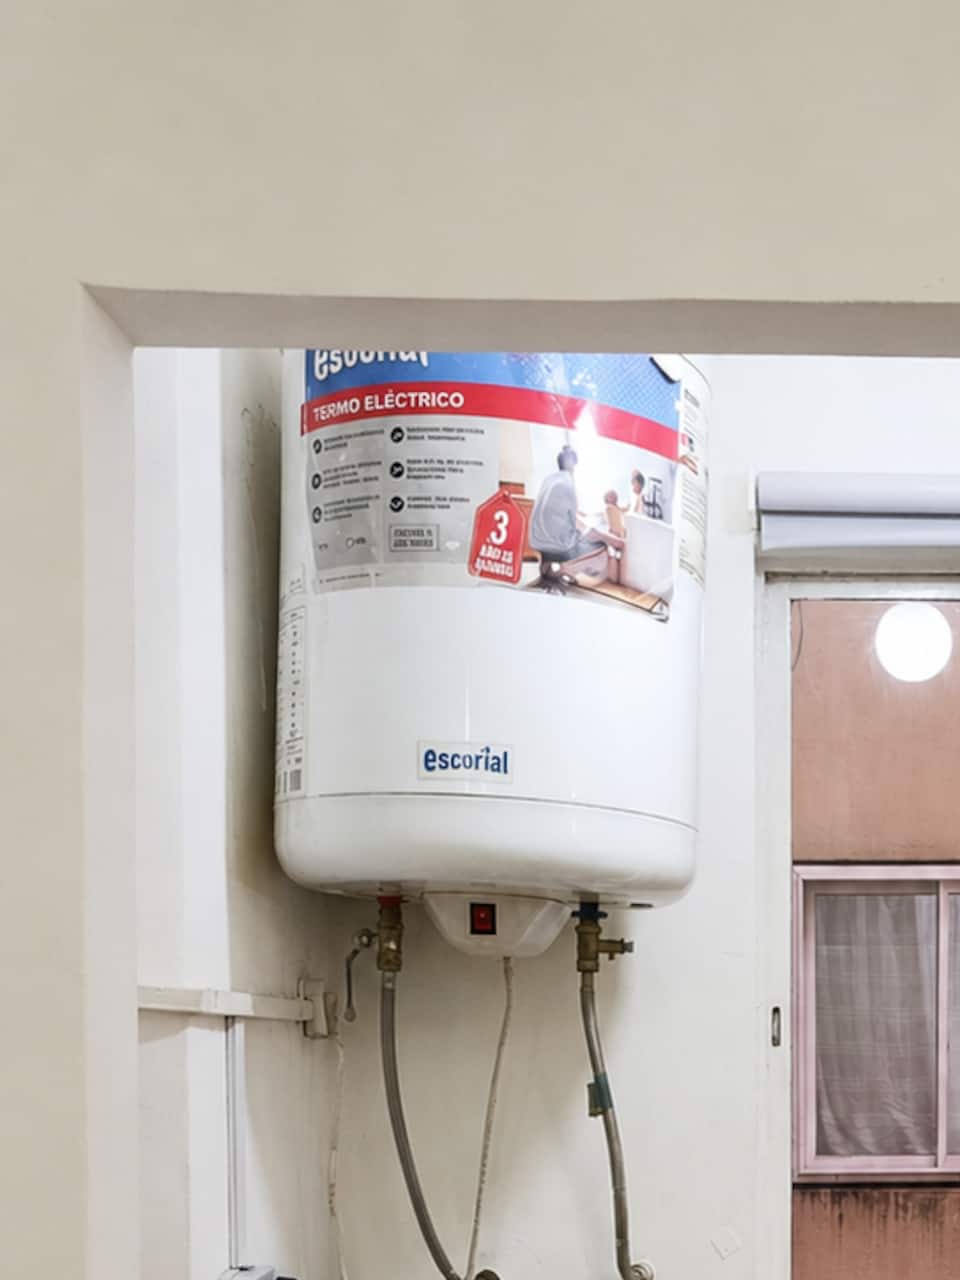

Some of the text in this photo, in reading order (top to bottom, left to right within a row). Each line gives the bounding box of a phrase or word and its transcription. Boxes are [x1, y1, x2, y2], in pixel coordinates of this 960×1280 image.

[315, 350, 428, 381] esco
[313, 389, 465, 422] TERMO ELÉCTRICO
[490, 510, 509, 545] 3
[424, 746, 508, 775] escorial
